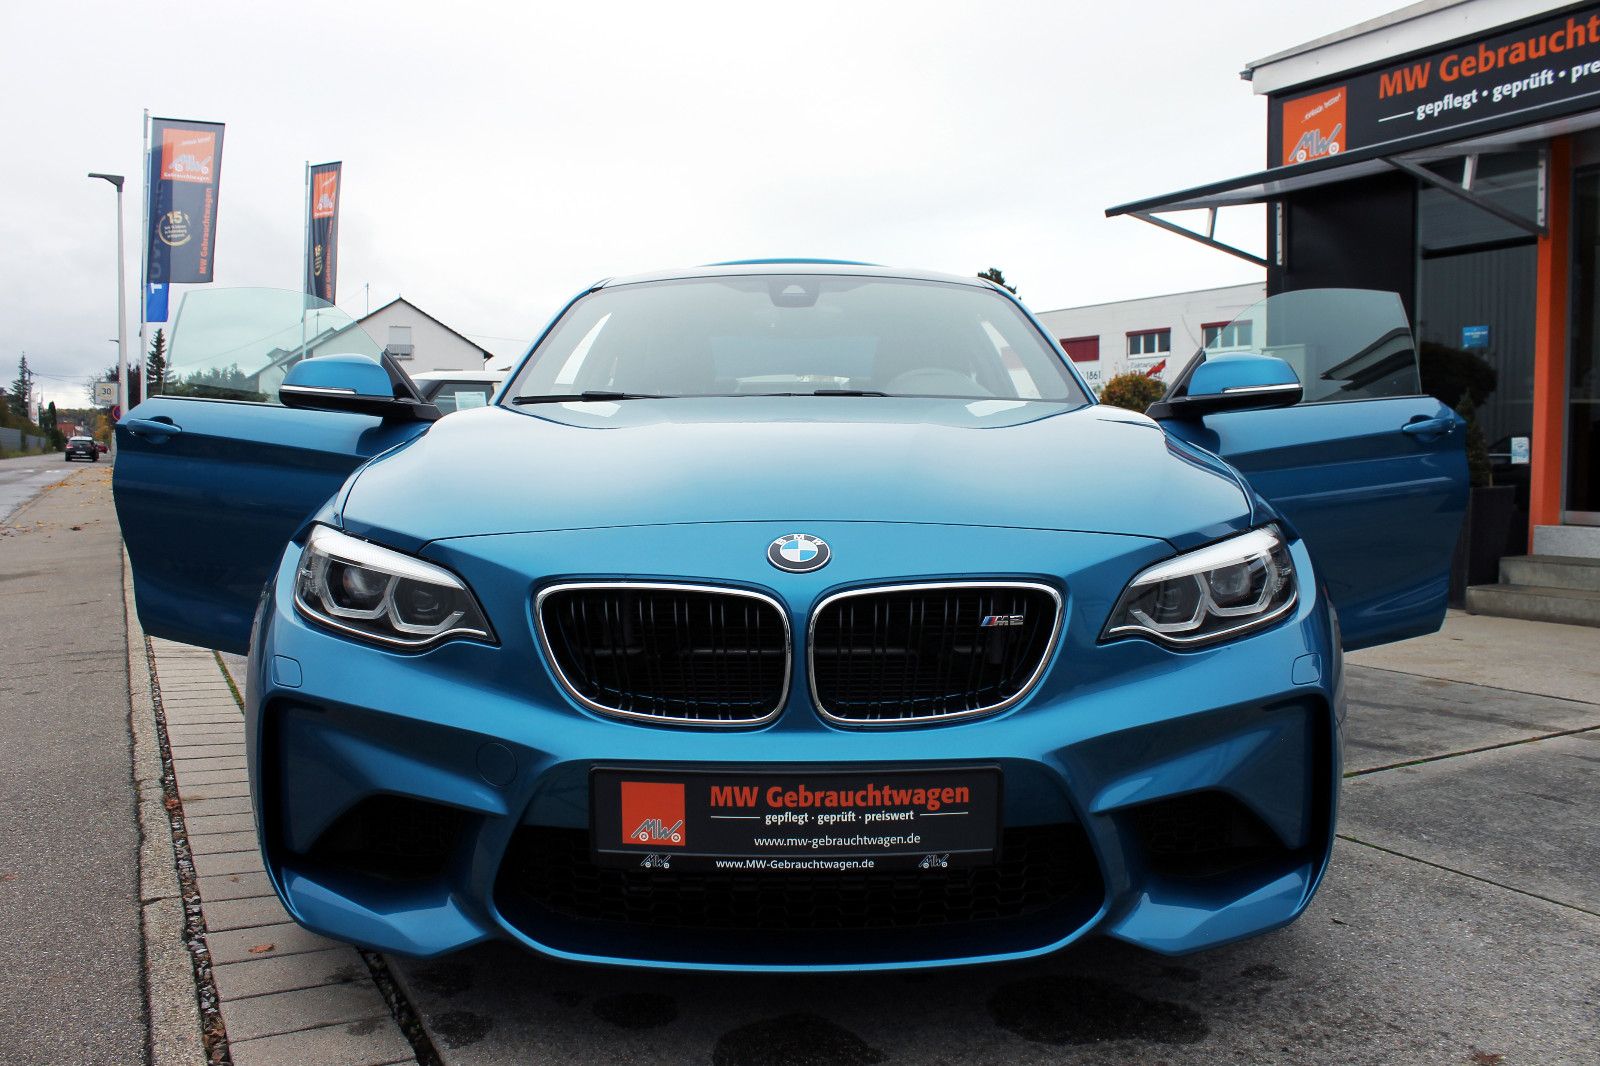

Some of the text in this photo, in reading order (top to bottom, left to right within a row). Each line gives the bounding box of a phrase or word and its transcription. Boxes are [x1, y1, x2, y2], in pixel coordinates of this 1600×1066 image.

[1379, 14, 1600, 99] MW Gebraucht
[1416, 60, 1600, 120] gepflegt geprüft pre
[167, 211, 182, 224] 15
[102, 387, 112, 395] 30
[710, 783, 970, 811] MW Gebrauchtwagen
[765, 810, 914, 825] gepflegt geprüft preiswert
[753, 833, 921, 849] www.mw-gebrauchtwagen.de
[715, 859, 875, 871] www.MW-Gebrauchtwagen.de
